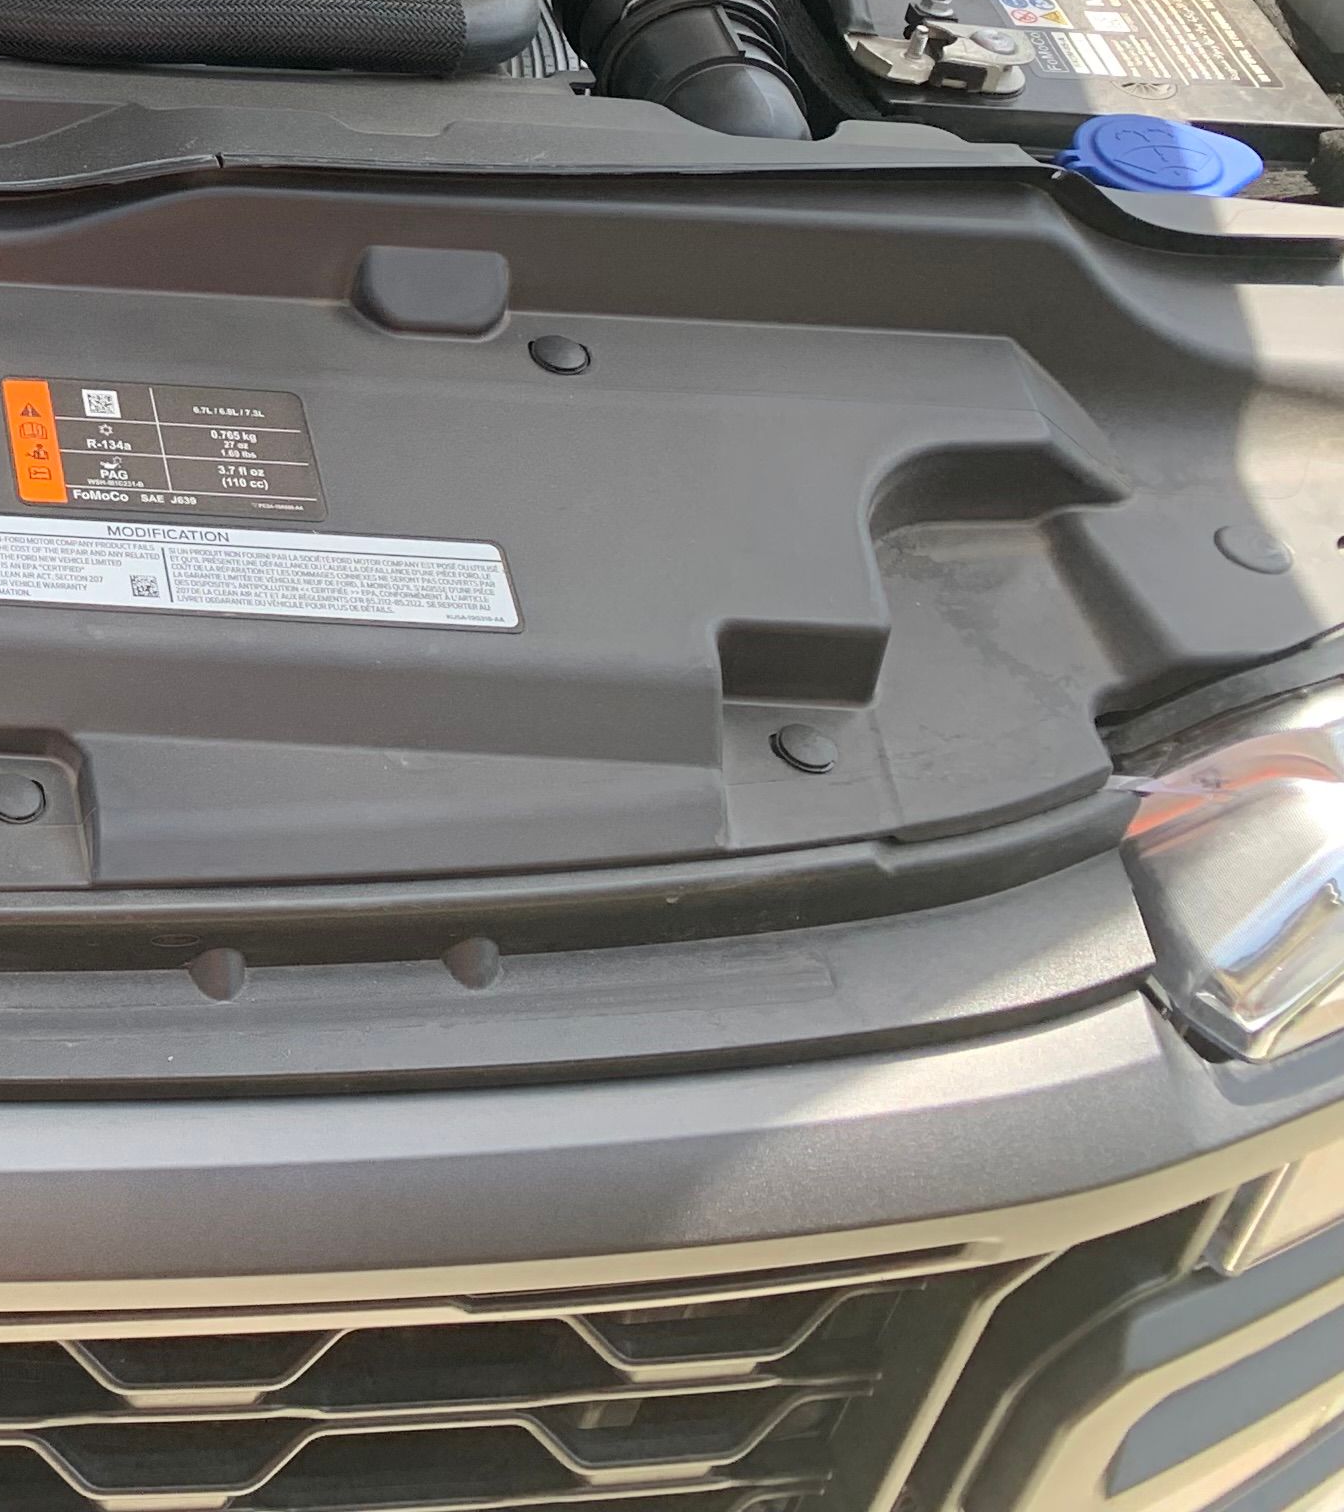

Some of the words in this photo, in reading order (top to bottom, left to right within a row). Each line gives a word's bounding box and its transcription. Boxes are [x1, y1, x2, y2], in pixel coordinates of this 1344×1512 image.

[1031, 31, 1063, 71] FoMoCo
[210, 429, 240, 440] 0.765
[241, 431, 257, 443] kg
[86, 438, 132, 451] R-134a
[223, 440, 235, 448] 27
[237, 441, 249, 449] oz
[241, 449, 257, 458] lbs
[99, 468, 128, 480] PAG
[217, 464, 235, 475] 3.7
[238, 465, 247, 475] fl
[249, 468, 265, 477] oz
[221, 476, 246, 488] (110
[249, 478, 268, 490] cc)
[72, 488, 129, 501] FoMoCo
[140, 493, 165, 504] SAE
[170, 495, 197, 506] J639
[107, 525, 230, 542] MODIFICATION
[26, 537, 55, 545] MOTOR
[55, 539, 93, 547] COMPANY
[95, 541, 130, 549] PRODUCT
[10, 544, 29, 552] COST
[60, 547, 89, 555] REPAIR
[124, 551, 159, 559] RELATED
[21, 562, 37, 570] EPA
[58, 556, 90, 564] VEHICLE
[90, 558, 122, 566] LIMITED
[54, 573, 88, 581] SECTION
[9, 579, 41, 587] VEHICLE
[42, 581, 87, 590] WARRANTY
